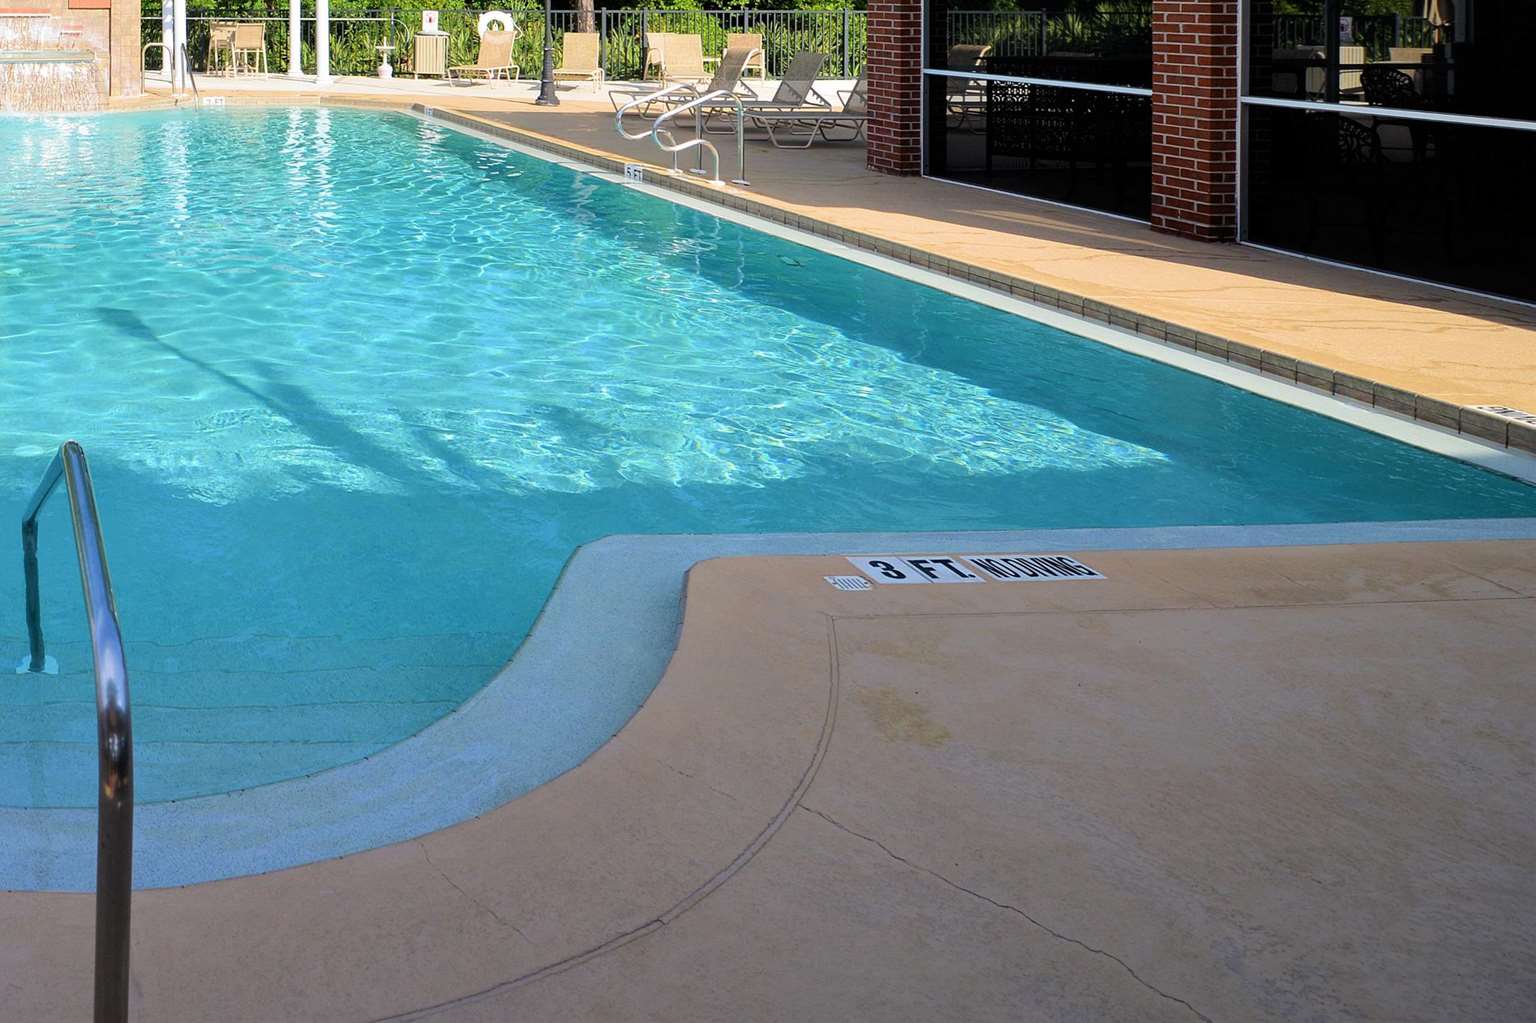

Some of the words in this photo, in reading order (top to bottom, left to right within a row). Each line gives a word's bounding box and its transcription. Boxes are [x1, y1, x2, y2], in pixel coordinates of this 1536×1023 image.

[867, 559, 907, 580] 3
[969, 557, 1020, 578] NO
[999, 556, 1100, 577] DIVING
